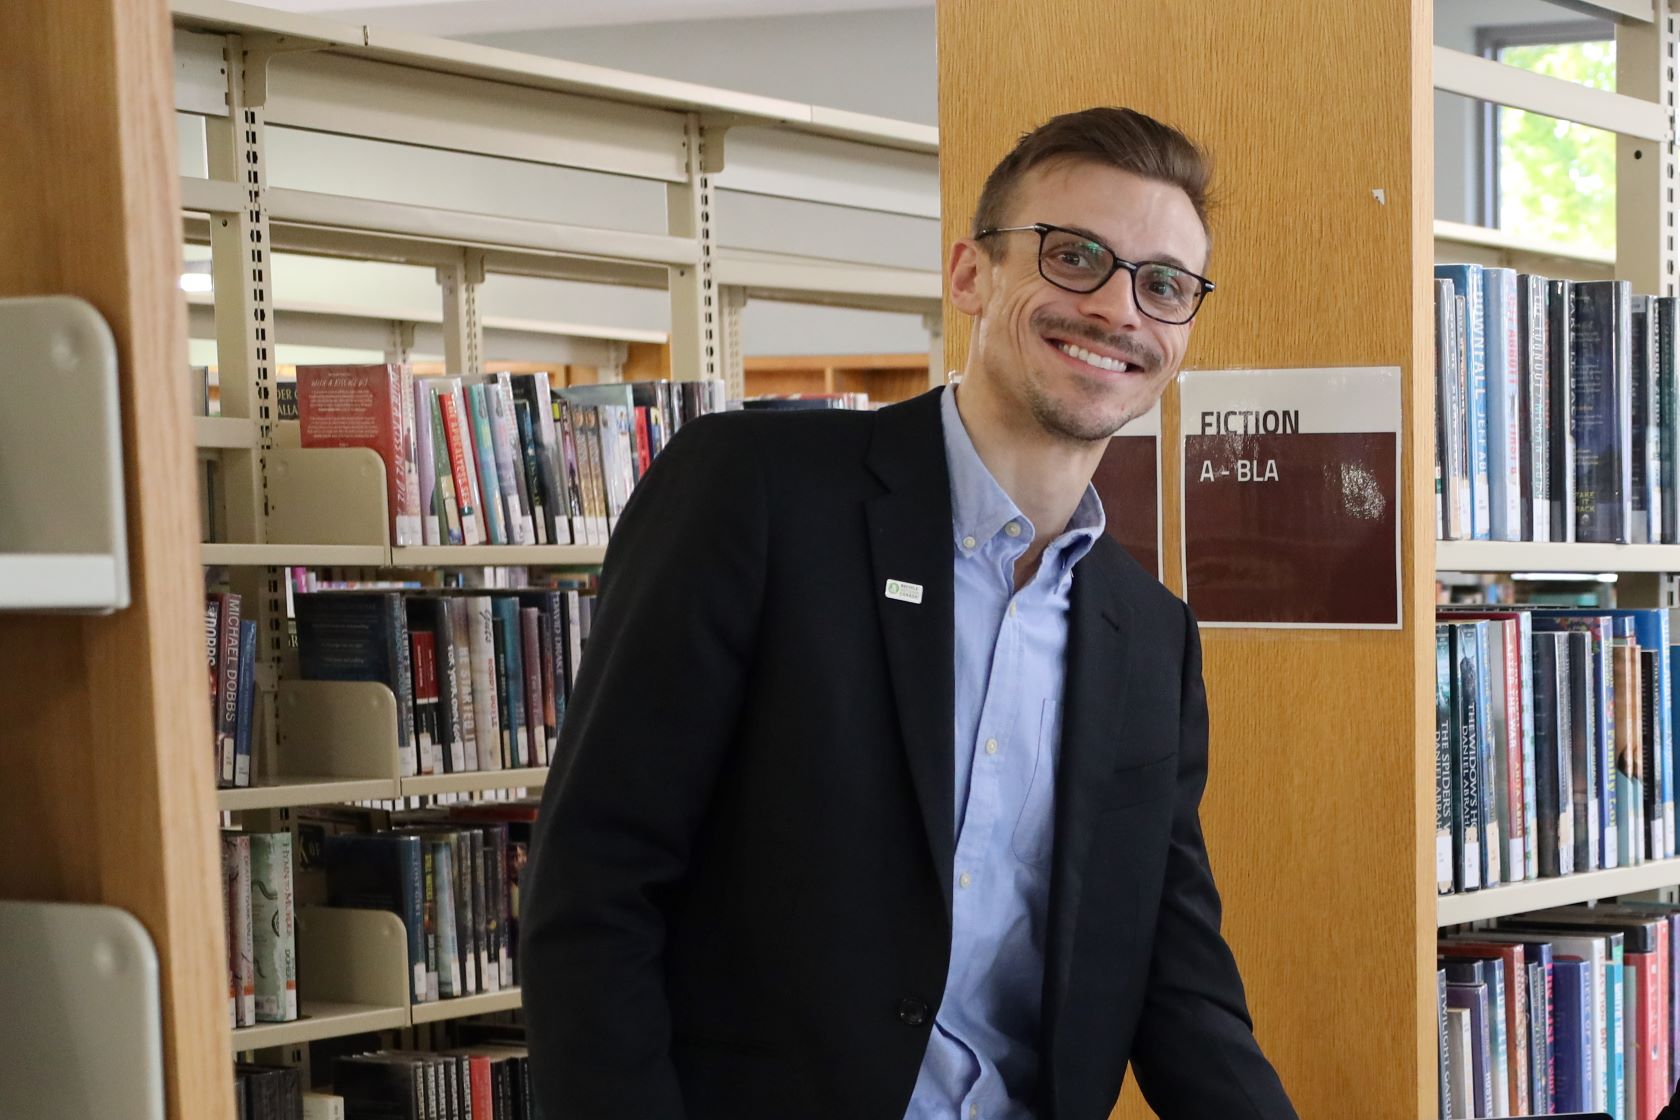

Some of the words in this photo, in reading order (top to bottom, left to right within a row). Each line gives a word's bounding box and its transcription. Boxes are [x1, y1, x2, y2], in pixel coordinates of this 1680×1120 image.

[1473, 291, 1487, 400] DOWNFALL
[1200, 409, 1300, 436] FICTION
[1199, 460, 1215, 482] A
[1237, 459, 1280, 482] BLA
[227, 599, 241, 665] MICHAEL
[552, 598, 561, 634] DAVID
[555, 637, 564, 674] DRAKE
[225, 671, 238, 722] DOBBS
[1441, 720, 1449, 749] THE
[1509, 719, 1517, 748] WAR
[1442, 753, 1451, 819] SPIDER'S
[1469, 732, 1478, 806] WIDOW'S
[1440, 993, 1450, 1066] TWILIGHT
